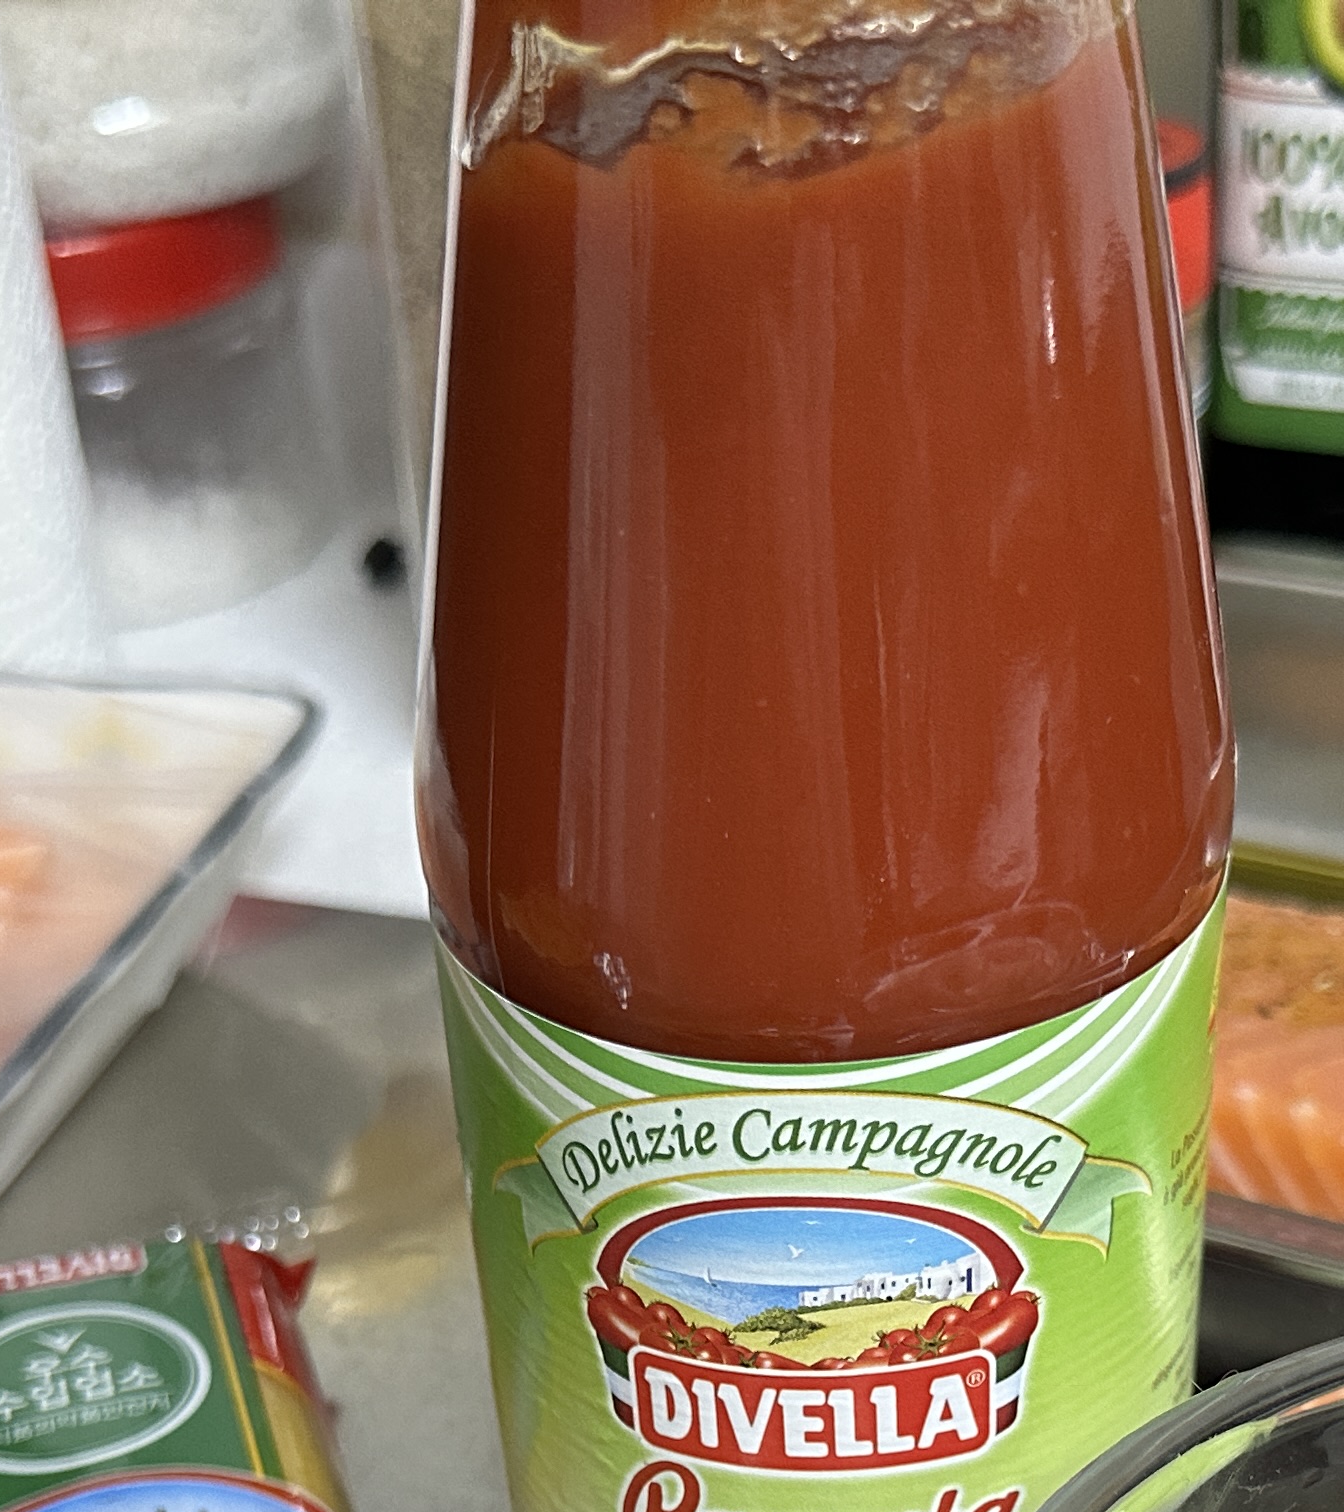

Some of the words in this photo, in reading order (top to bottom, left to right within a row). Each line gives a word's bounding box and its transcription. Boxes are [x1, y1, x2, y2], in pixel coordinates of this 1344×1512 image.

[562, 1106, 717, 1193] Delizie
[733, 1108, 1059, 1191] Campagnole
[644, 1366, 980, 1459] DIVELLA
